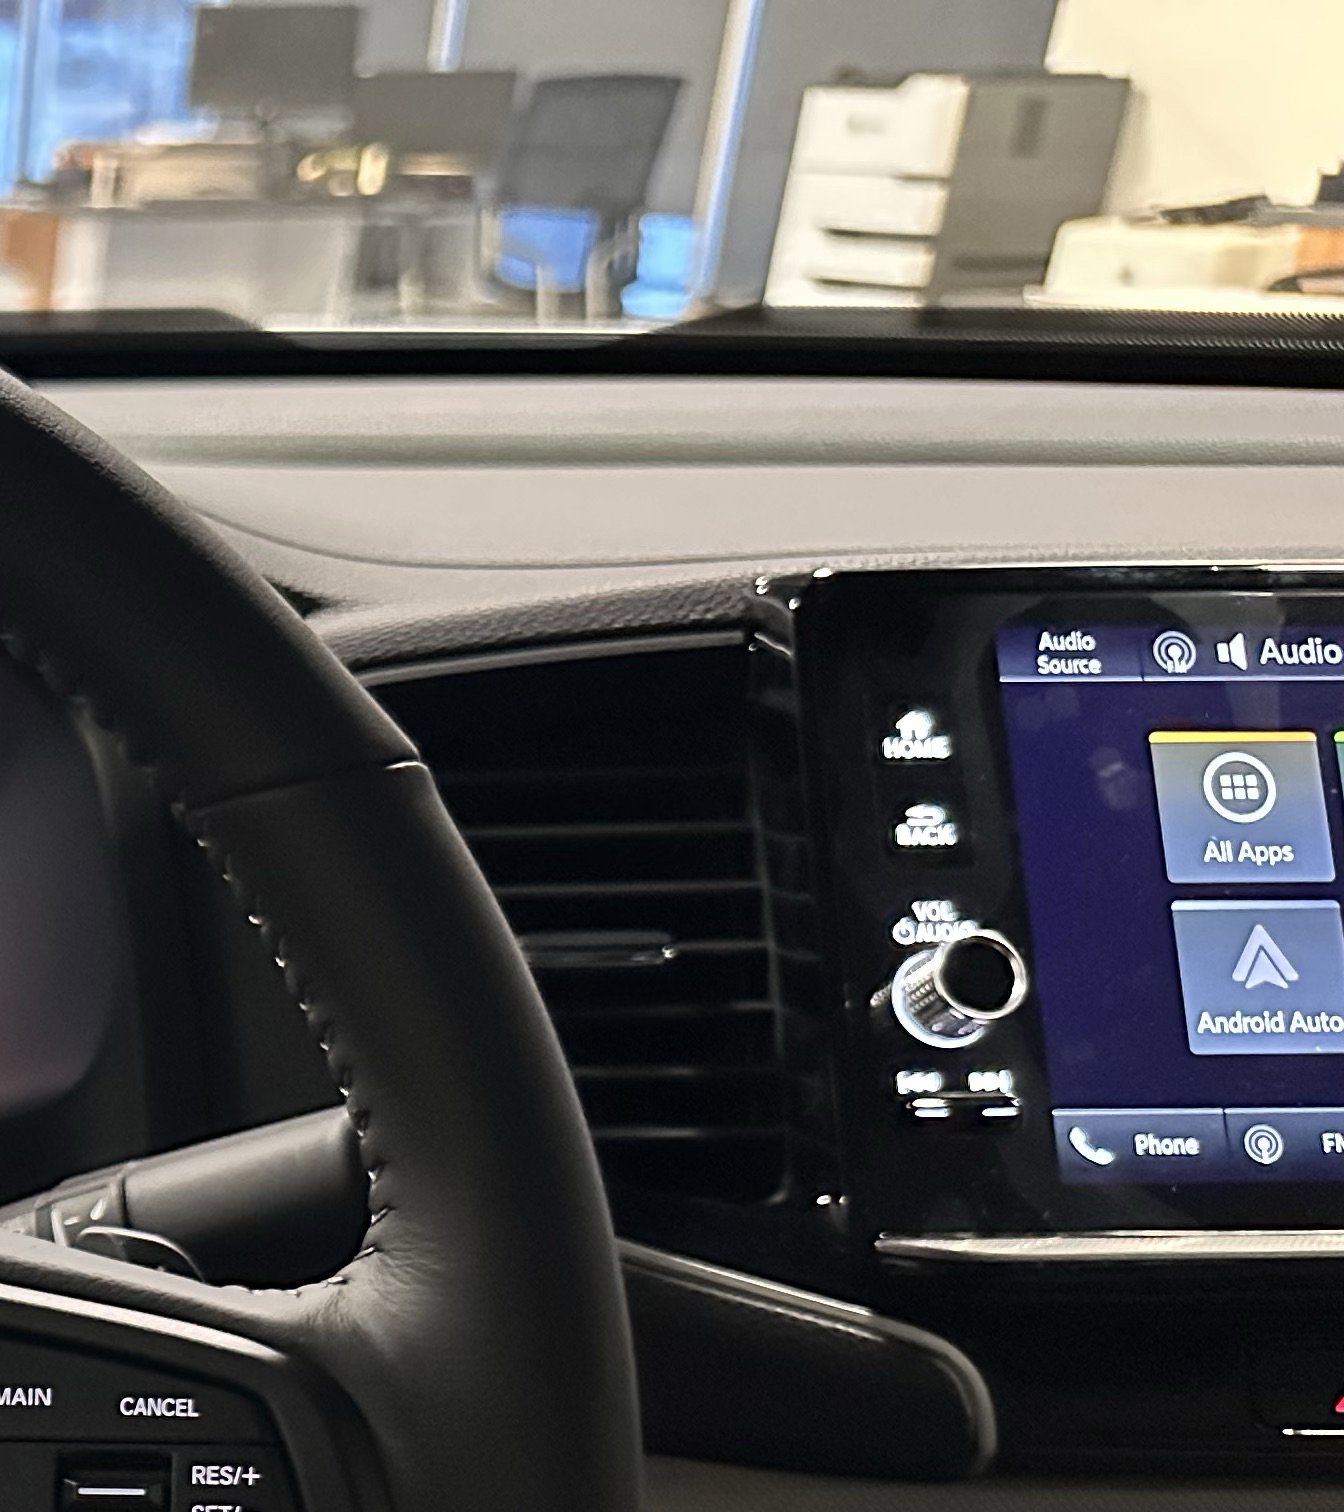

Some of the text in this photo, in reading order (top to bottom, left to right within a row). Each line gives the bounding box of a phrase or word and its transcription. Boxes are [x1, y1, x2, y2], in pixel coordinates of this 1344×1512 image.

[1038, 631, 1096, 653] Audio
[1260, 638, 1343, 665] Audio
[1037, 655, 1102, 676] Source
[882, 737, 952, 759] HOME
[895, 823, 957, 846] BACK
[1204, 841, 1294, 866] All Apps
[911, 901, 956, 921] VOL
[1197, 1011, 1344, 1034] Android Auto
[1134, 1132, 1200, 1155] Phone
[120, 1397, 200, 1418] CANCEL
[192, 1466, 261, 1486] RES/+
